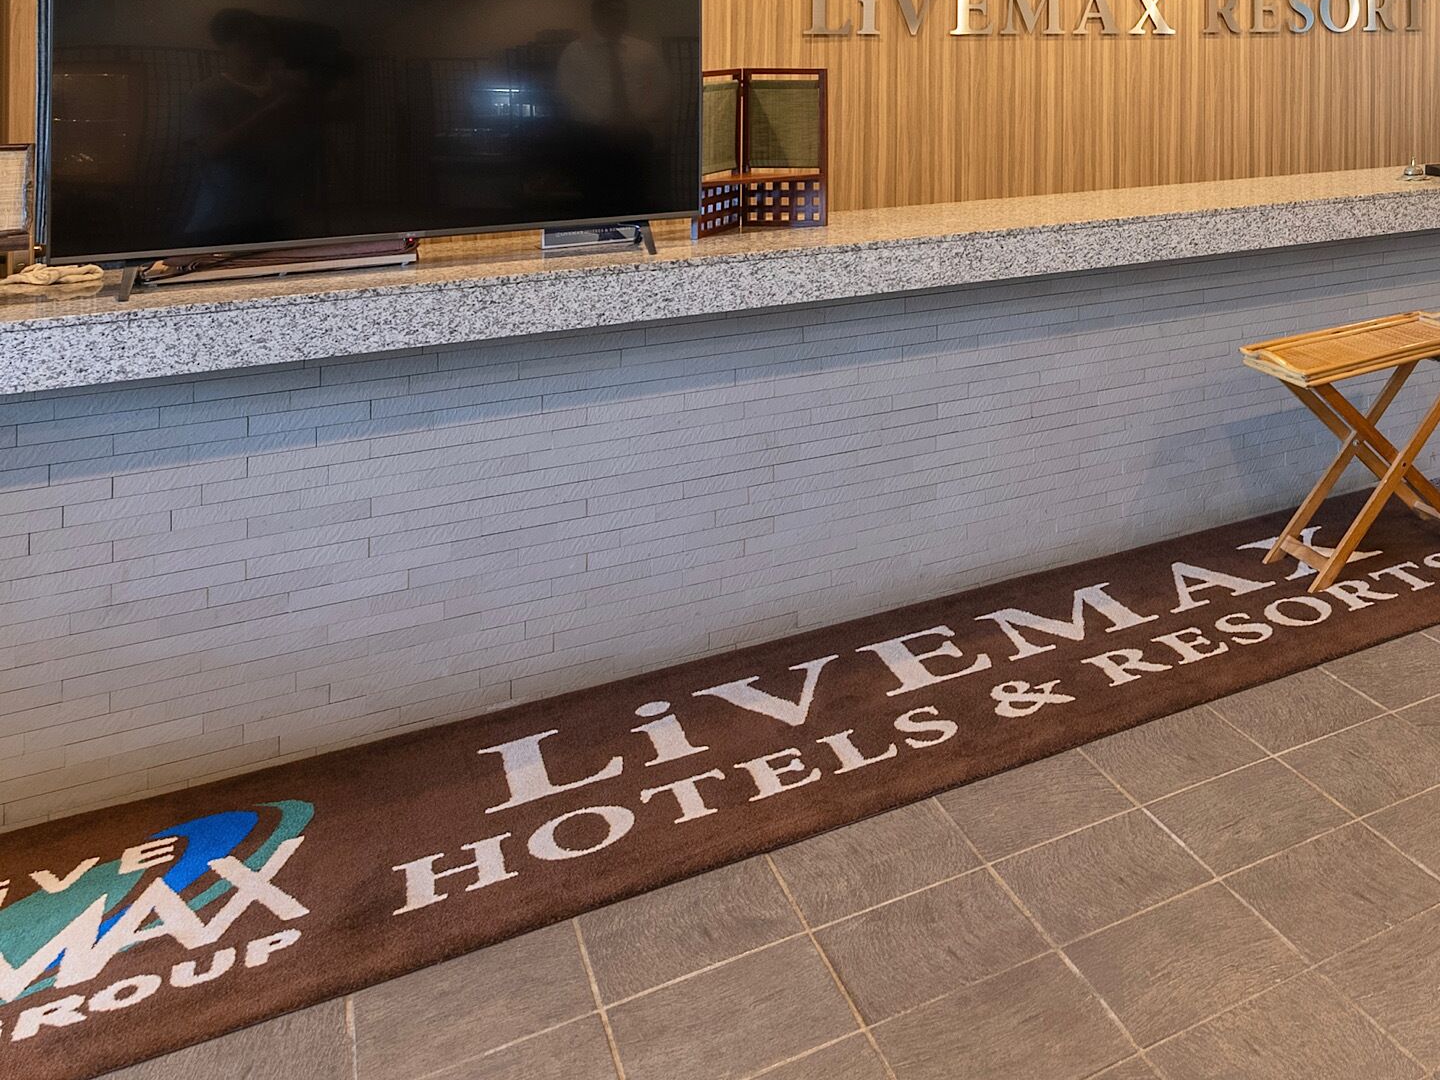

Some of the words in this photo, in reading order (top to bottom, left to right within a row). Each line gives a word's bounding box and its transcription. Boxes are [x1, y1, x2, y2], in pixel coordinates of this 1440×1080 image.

[392, 705, 959, 915] HOTELS
[990, 679, 1075, 718] &
[0, 835, 310, 1003] MAX
[0, 928, 302, 1042] ROUP
